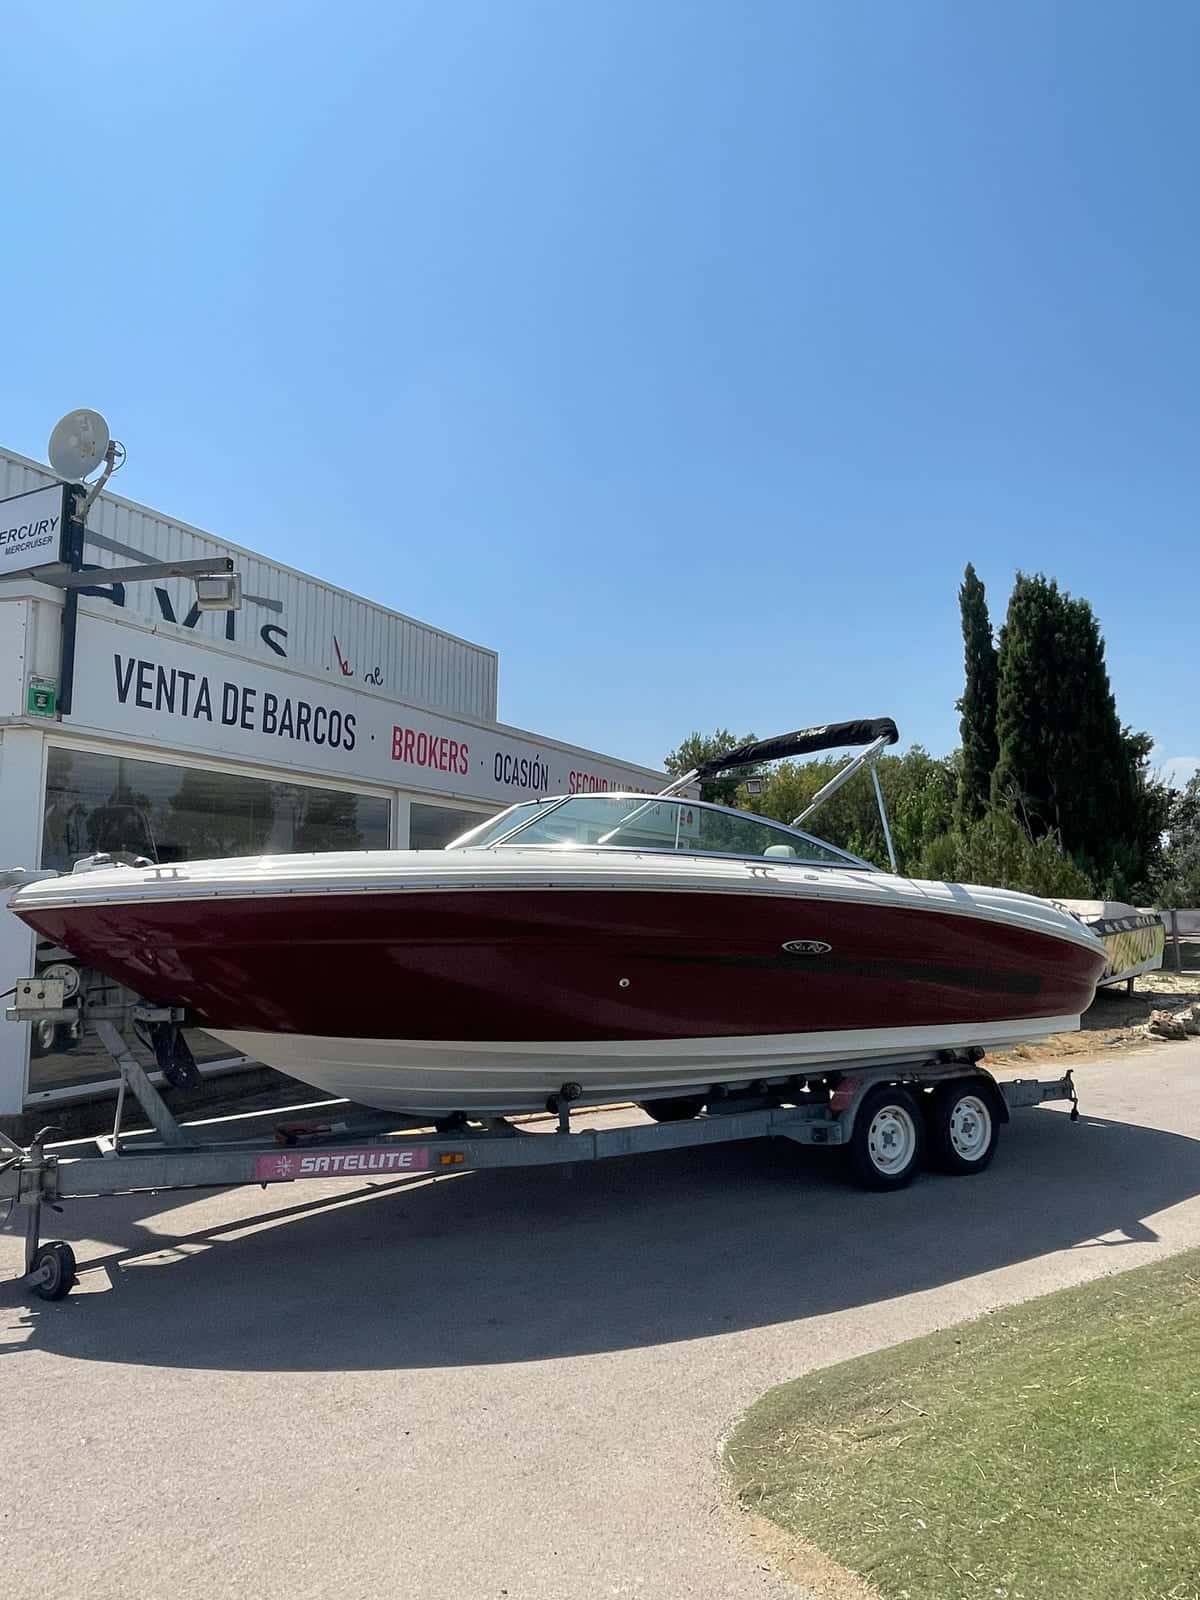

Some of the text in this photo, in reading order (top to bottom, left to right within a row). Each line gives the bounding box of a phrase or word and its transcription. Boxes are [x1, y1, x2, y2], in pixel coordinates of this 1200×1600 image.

[0, 516, 59, 545] ERCURY
[114, 654, 213, 722] VENTA
[221, 682, 257, 730] DE
[262, 693, 356, 751] BARCOS
[391, 726, 469, 775] BROKERS
[494, 754, 549, 792] OCASIÓN
[300, 1152, 413, 1172] SATELLITE
